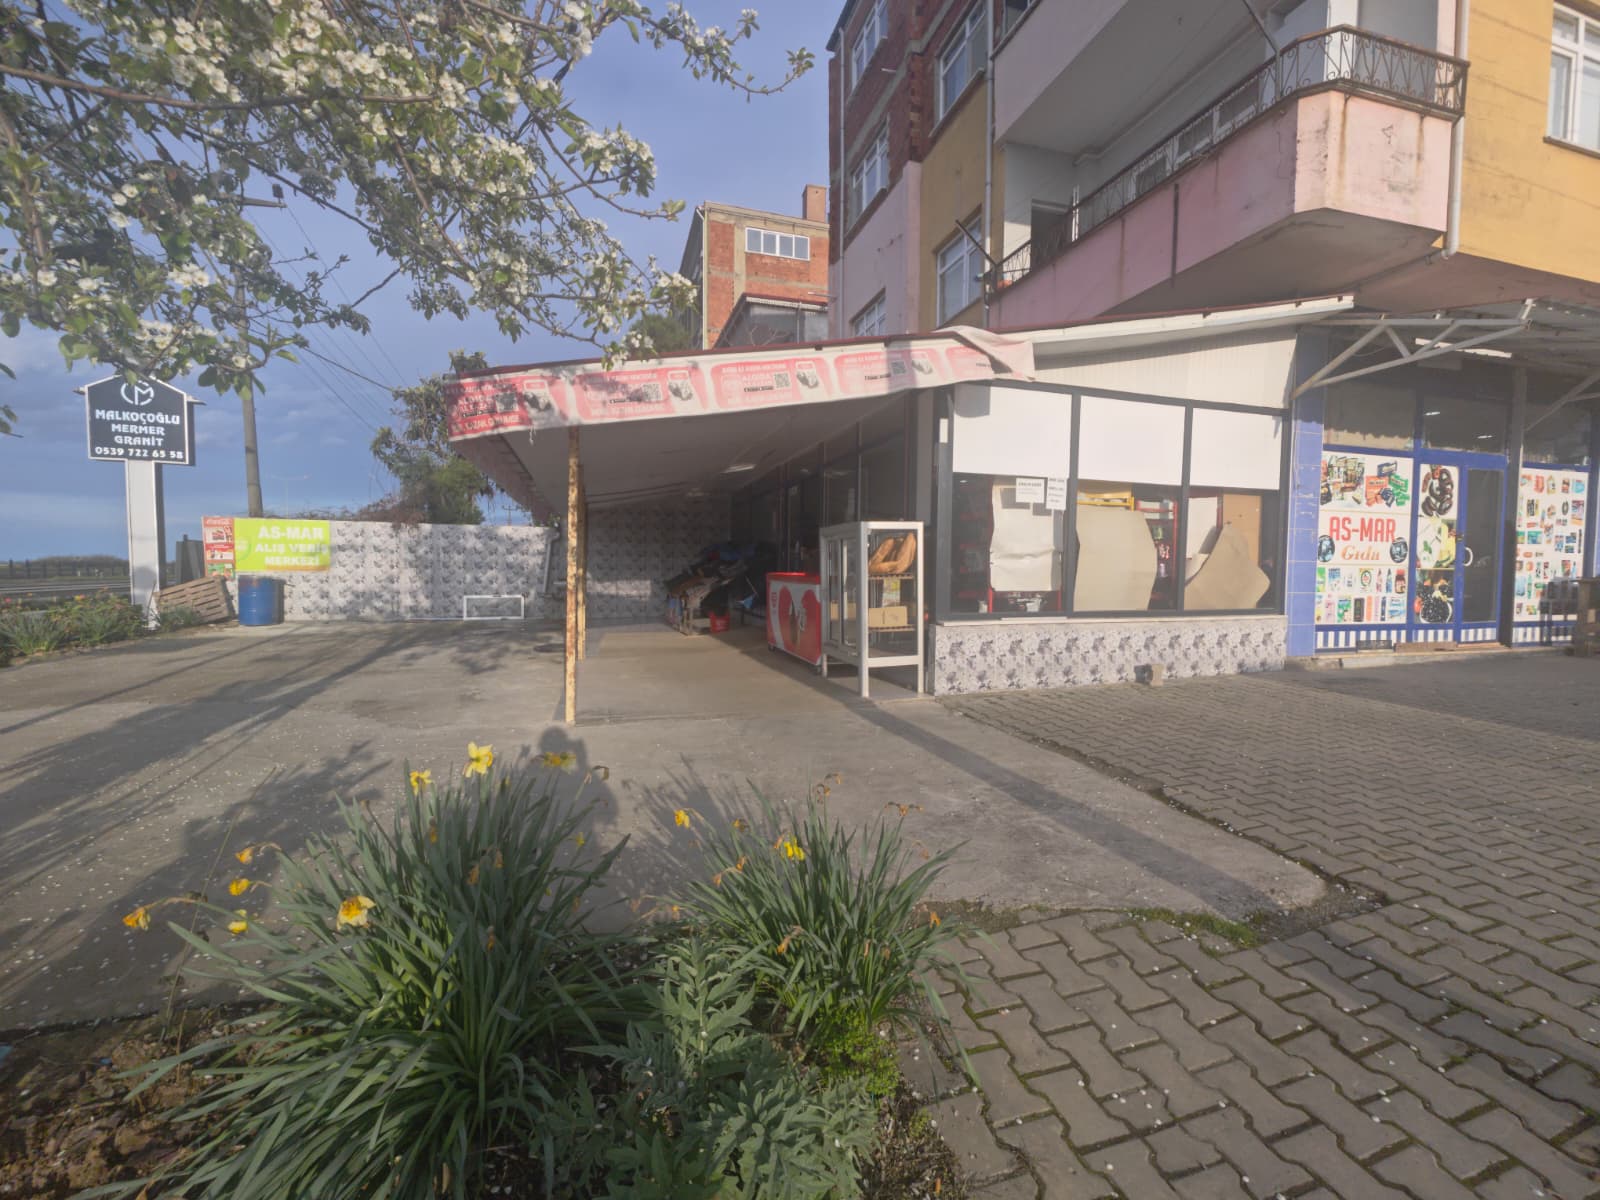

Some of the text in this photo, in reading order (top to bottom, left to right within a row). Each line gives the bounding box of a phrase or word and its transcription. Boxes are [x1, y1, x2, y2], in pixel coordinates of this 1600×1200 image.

[95, 409, 180, 425] MALKOÇOĞLU
[111, 423, 166, 436] MERMER
[114, 435, 164, 447] GRANİT
[95, 446, 125, 456] 0539
[128, 448, 149, 457] 722
[257, 525, 324, 541] AS-MAR
[1329, 515, 1397, 543] AS-MAR
[264, 555, 320, 566] MERKEZİ
